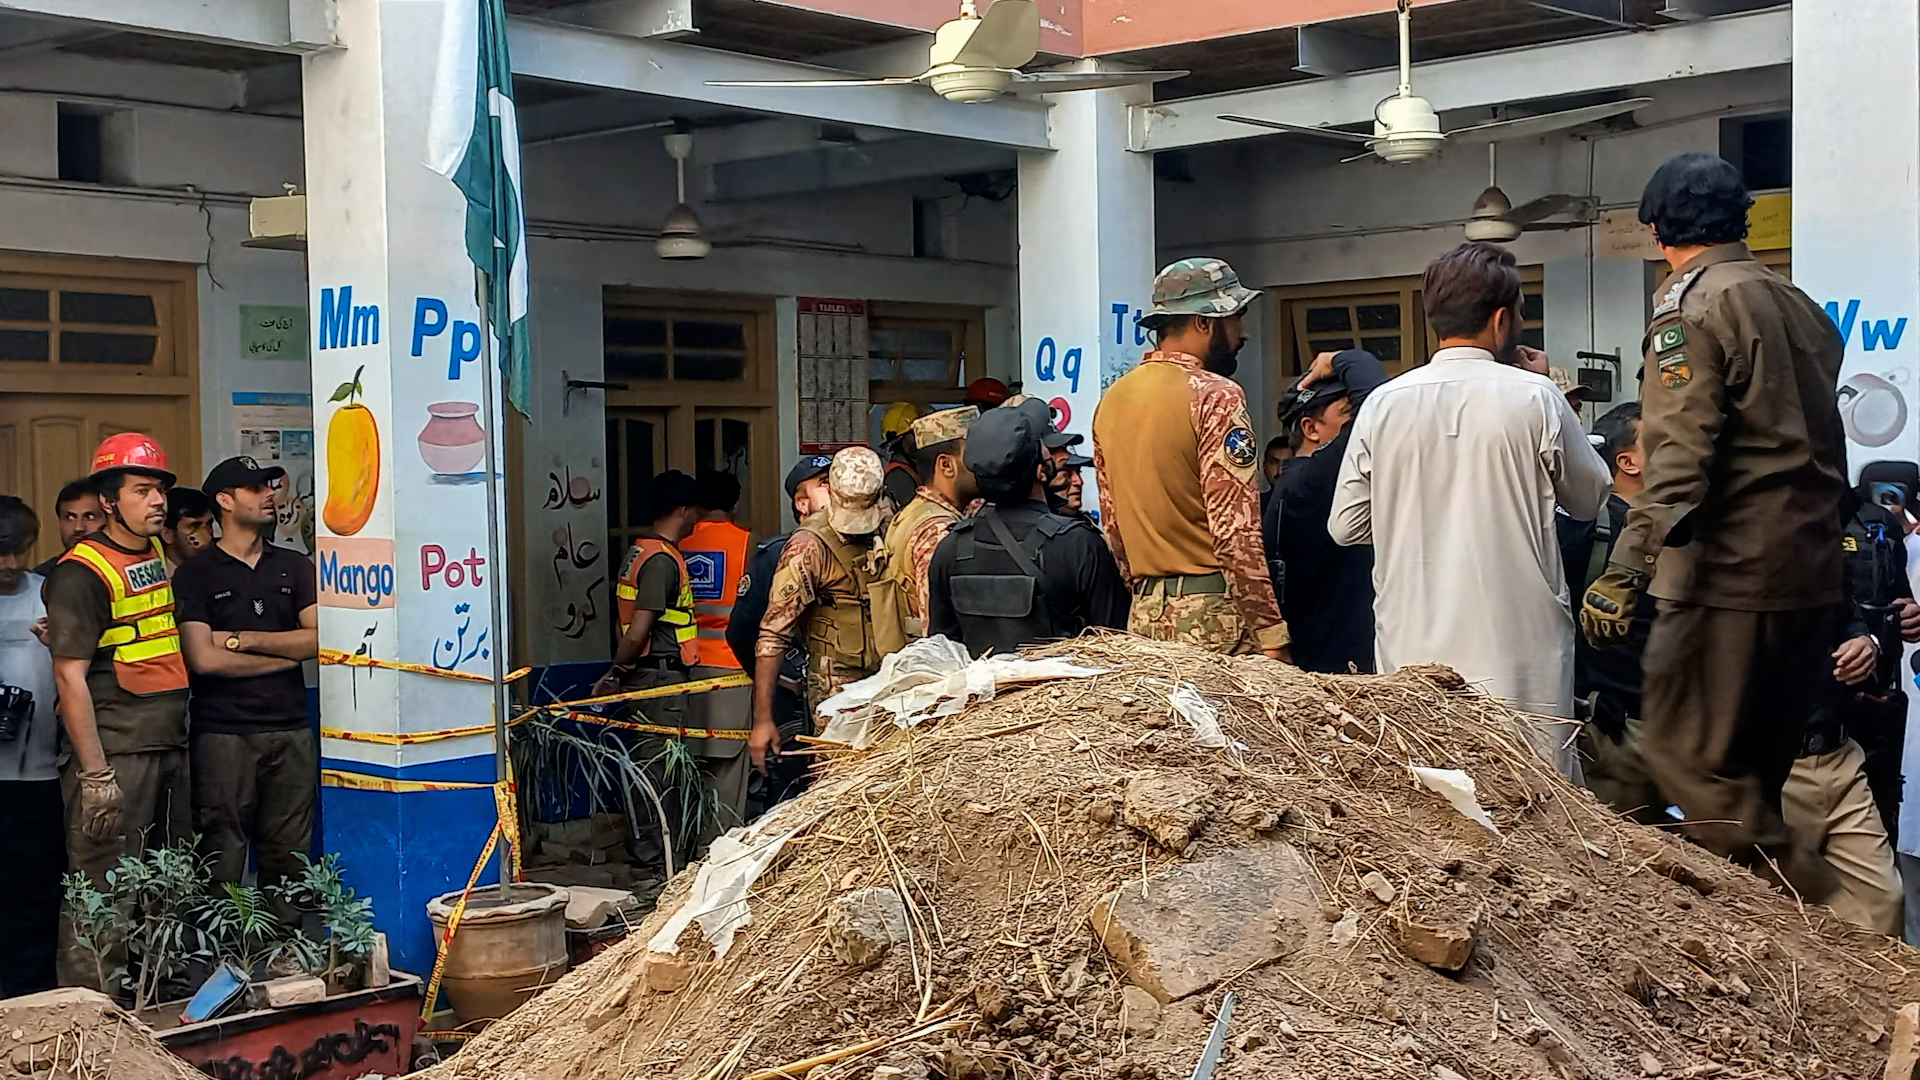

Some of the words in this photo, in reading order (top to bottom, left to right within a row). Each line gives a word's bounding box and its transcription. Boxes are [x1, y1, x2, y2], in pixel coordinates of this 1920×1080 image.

[319, 285, 379, 350] Mm
[411, 297, 481, 380] Pp
[1111, 303, 1146, 346] Tt
[1036, 337, 1082, 393] Qq
[320, 550, 394, 606] Mango
[420, 544, 485, 591] Pot
[432, 602, 490, 671] برتن
